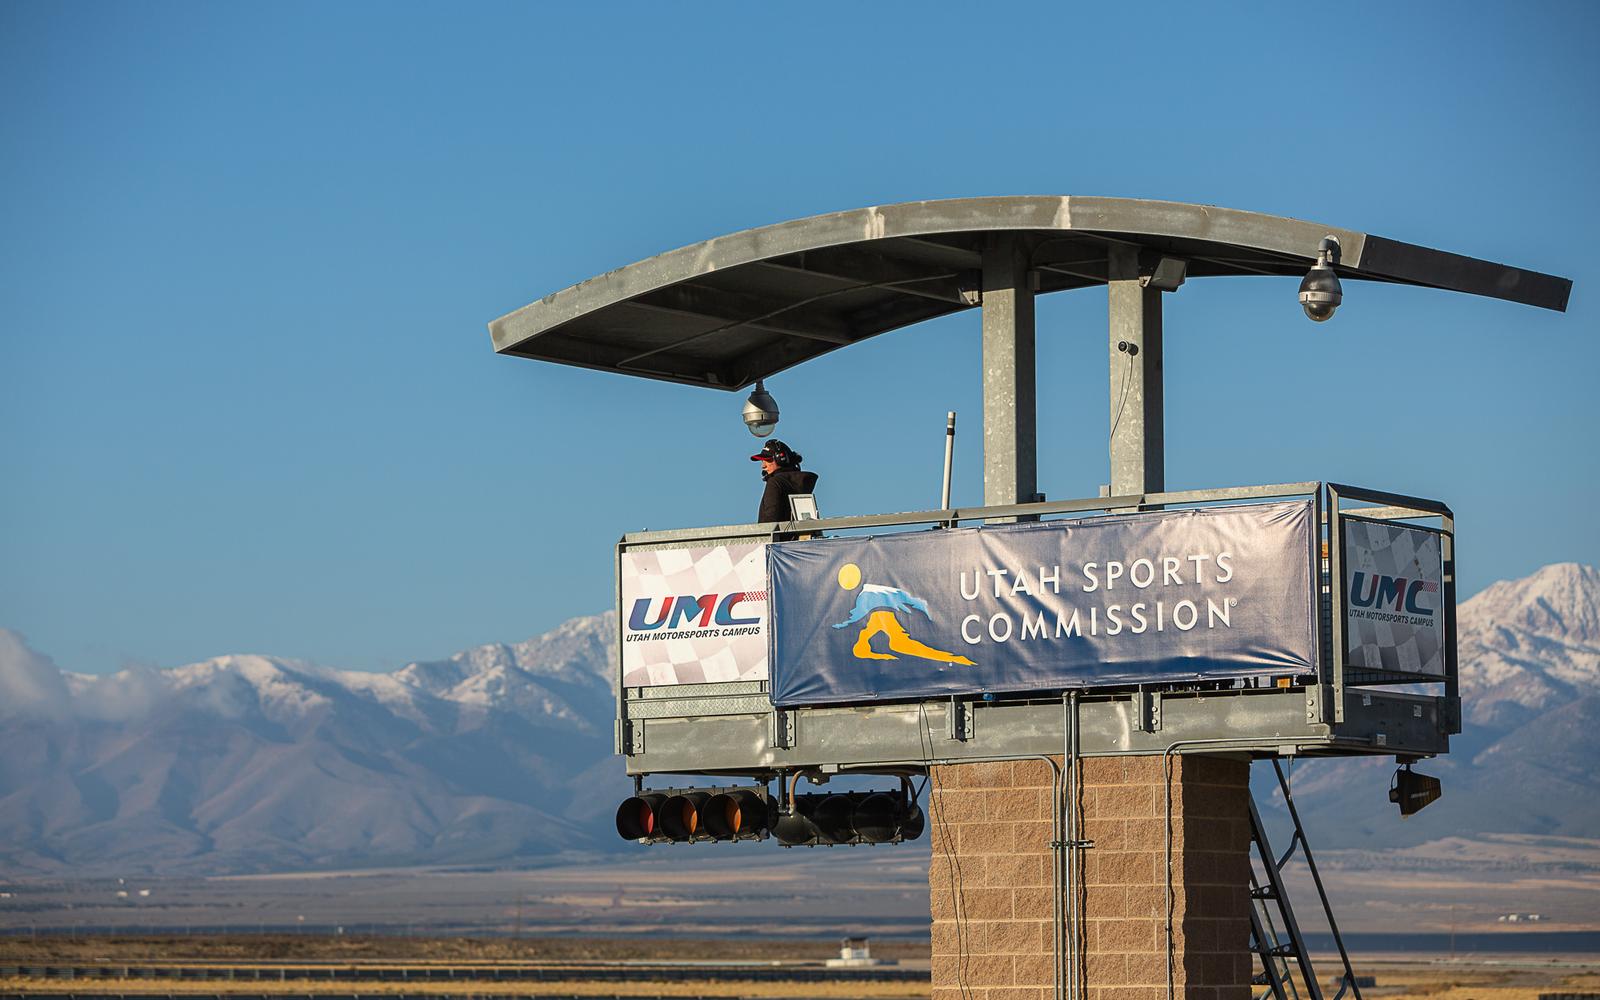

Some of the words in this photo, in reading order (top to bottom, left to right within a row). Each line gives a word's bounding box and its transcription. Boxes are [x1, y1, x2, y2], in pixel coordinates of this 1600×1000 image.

[960, 566, 1060, 600] UTAH
[1082, 552, 1233, 592] SPORTS
[1350, 571, 1434, 616] UMC
[628, 592, 762, 631] UMC
[1349, 609, 1365, 618] UTAH
[1366, 611, 1409, 624] MOTORSPORTS
[1409, 616, 1434, 627] CAMPUS
[626, 633, 651, 642] UTAH
[652, 629, 720, 641] MOTORSPORTS
[722, 626, 760, 637] CAMPUS
